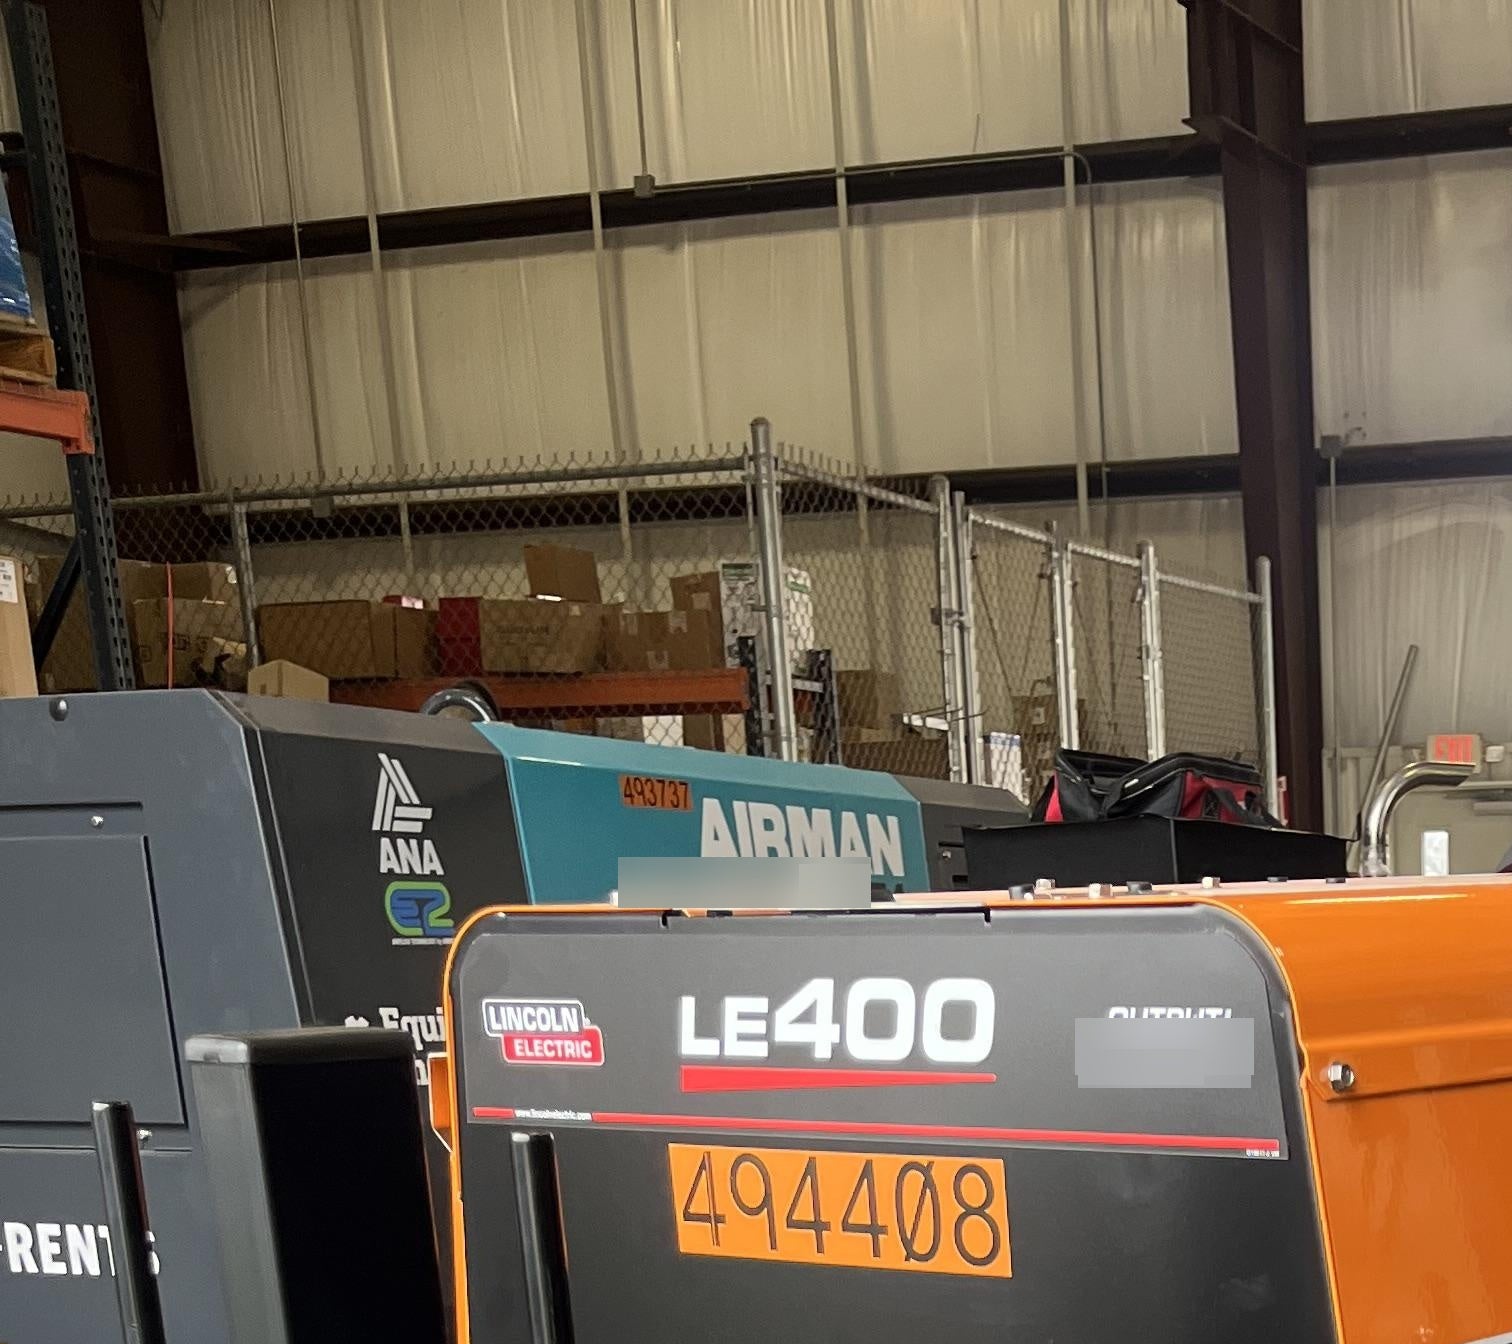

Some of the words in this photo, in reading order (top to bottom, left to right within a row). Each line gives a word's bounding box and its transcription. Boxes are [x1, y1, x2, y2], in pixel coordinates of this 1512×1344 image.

[622, 775, 690, 809] 493737
[379, 836, 445, 876] ANA
[701, 797, 905, 877] AIRMAN
[488, 1005, 580, 1033] LINCOLN
[680, 977, 997, 1065] LE400
[513, 1038, 593, 1060] ELECTRIC
[681, 1151, 999, 1267] 494408
